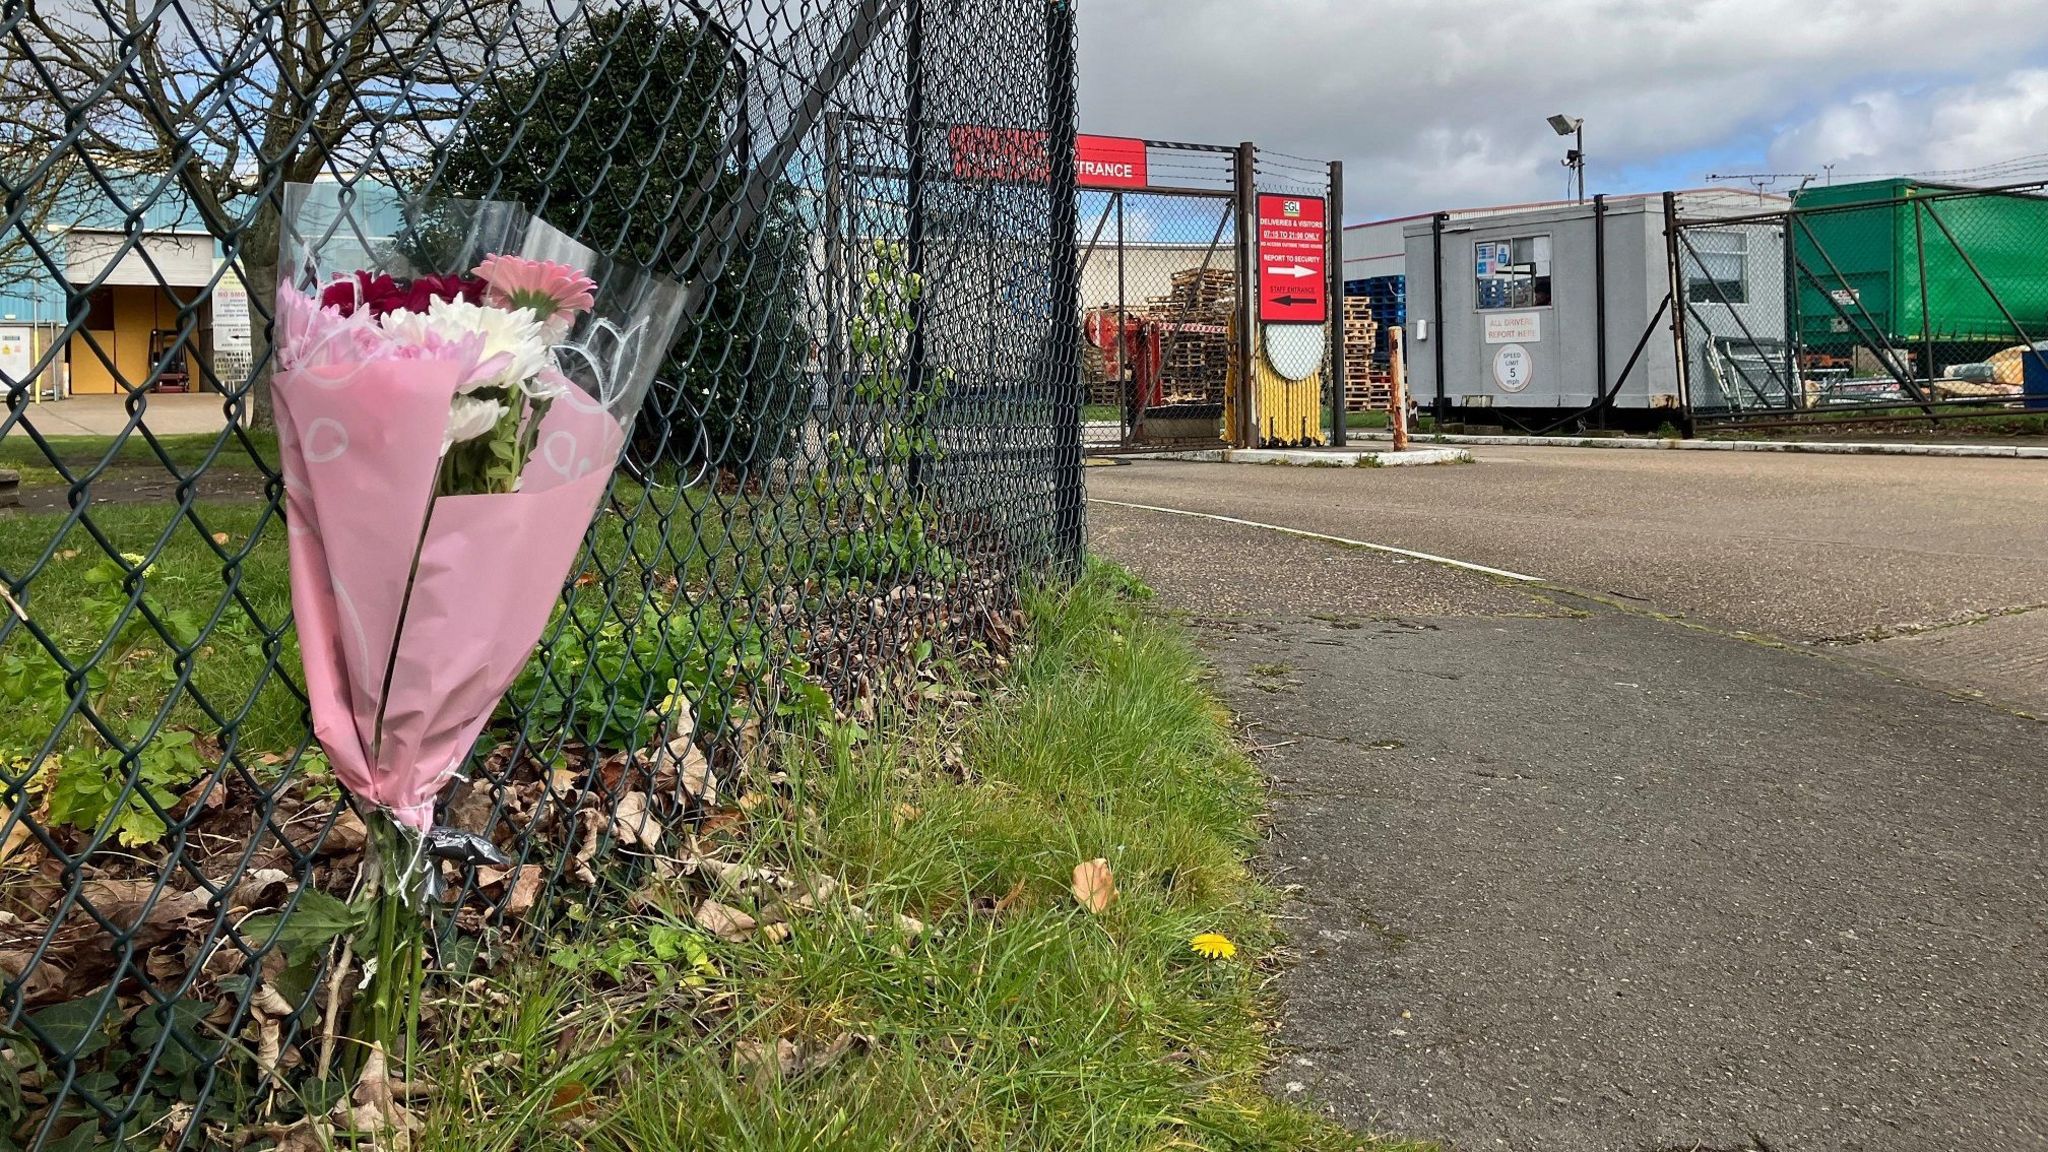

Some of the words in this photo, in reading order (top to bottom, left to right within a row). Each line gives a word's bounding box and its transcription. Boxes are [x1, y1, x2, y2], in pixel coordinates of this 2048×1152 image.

[1074, 160, 1134, 178] TRANCE
[1284, 201, 1299, 212] EGL
[1260, 218, 1291, 227] DELIVERIES
[1298, 220, 1323, 228] VISITORS
[1304, 232, 1320, 240] ONLY
[1263, 254, 1285, 262] REPORT
[1295, 255, 1320, 263] SECURITY
[1488, 330, 1515, 338] REPORT
[1510, 368, 1516, 378] 5
